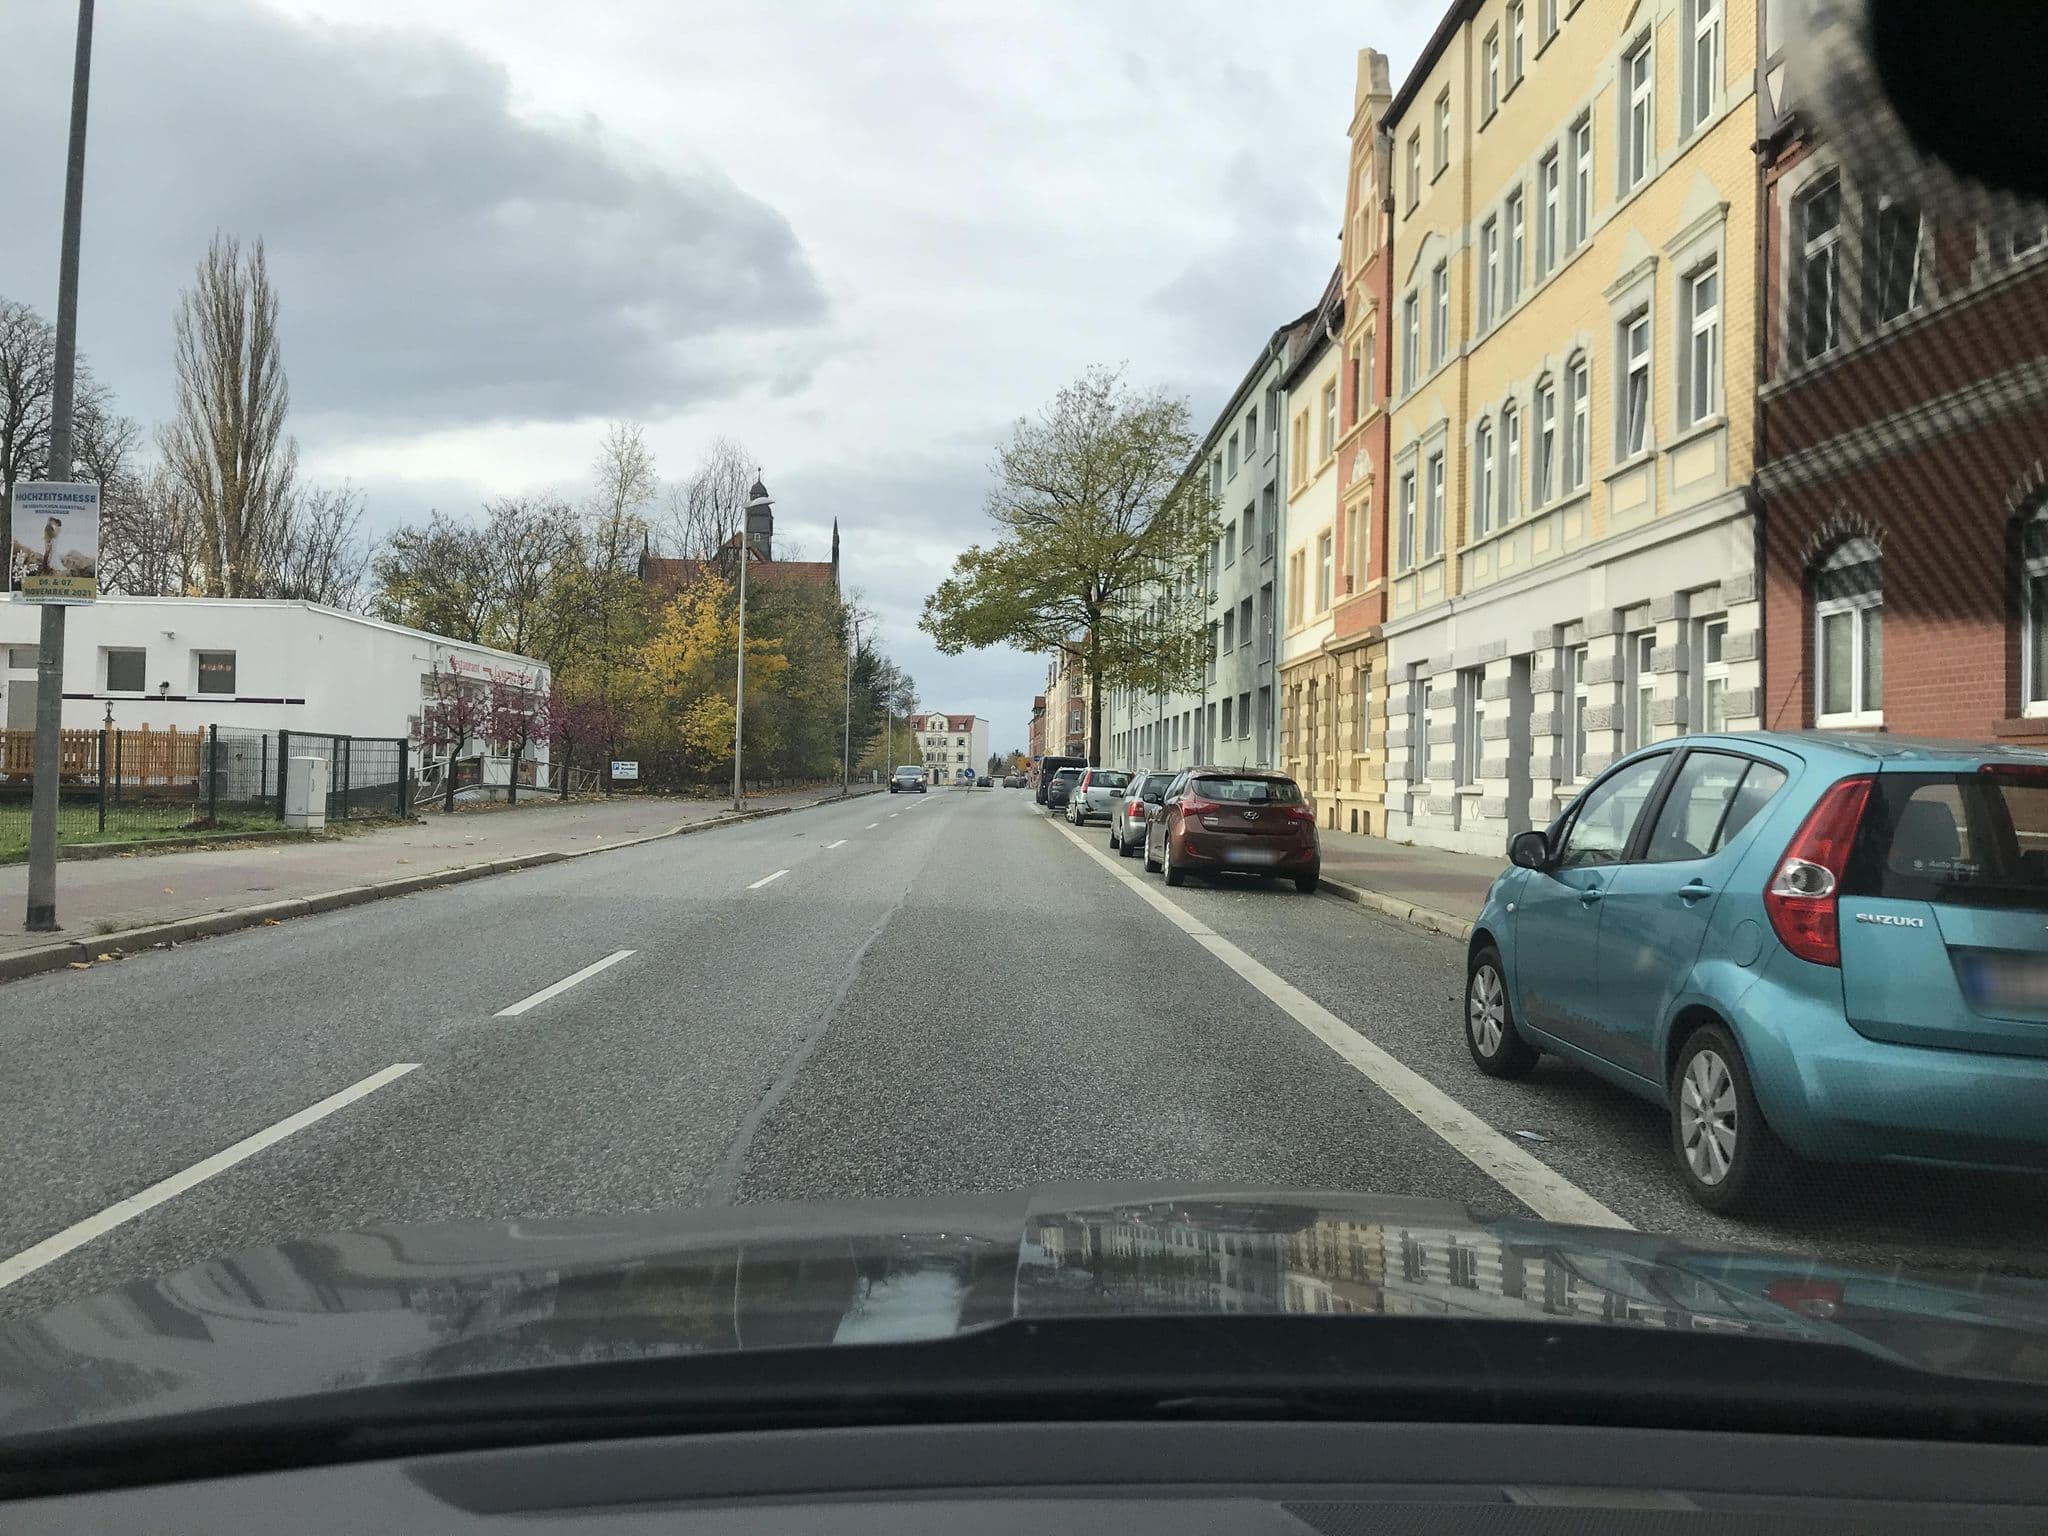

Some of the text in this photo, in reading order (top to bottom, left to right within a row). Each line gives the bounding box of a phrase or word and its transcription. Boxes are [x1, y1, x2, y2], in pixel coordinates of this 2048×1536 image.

[15, 492, 97, 503] HOCHZEITSMESSE
[25, 588, 92, 597] NOVEMBER 2021
[1855, 913, 1925, 928] SUZUKI
